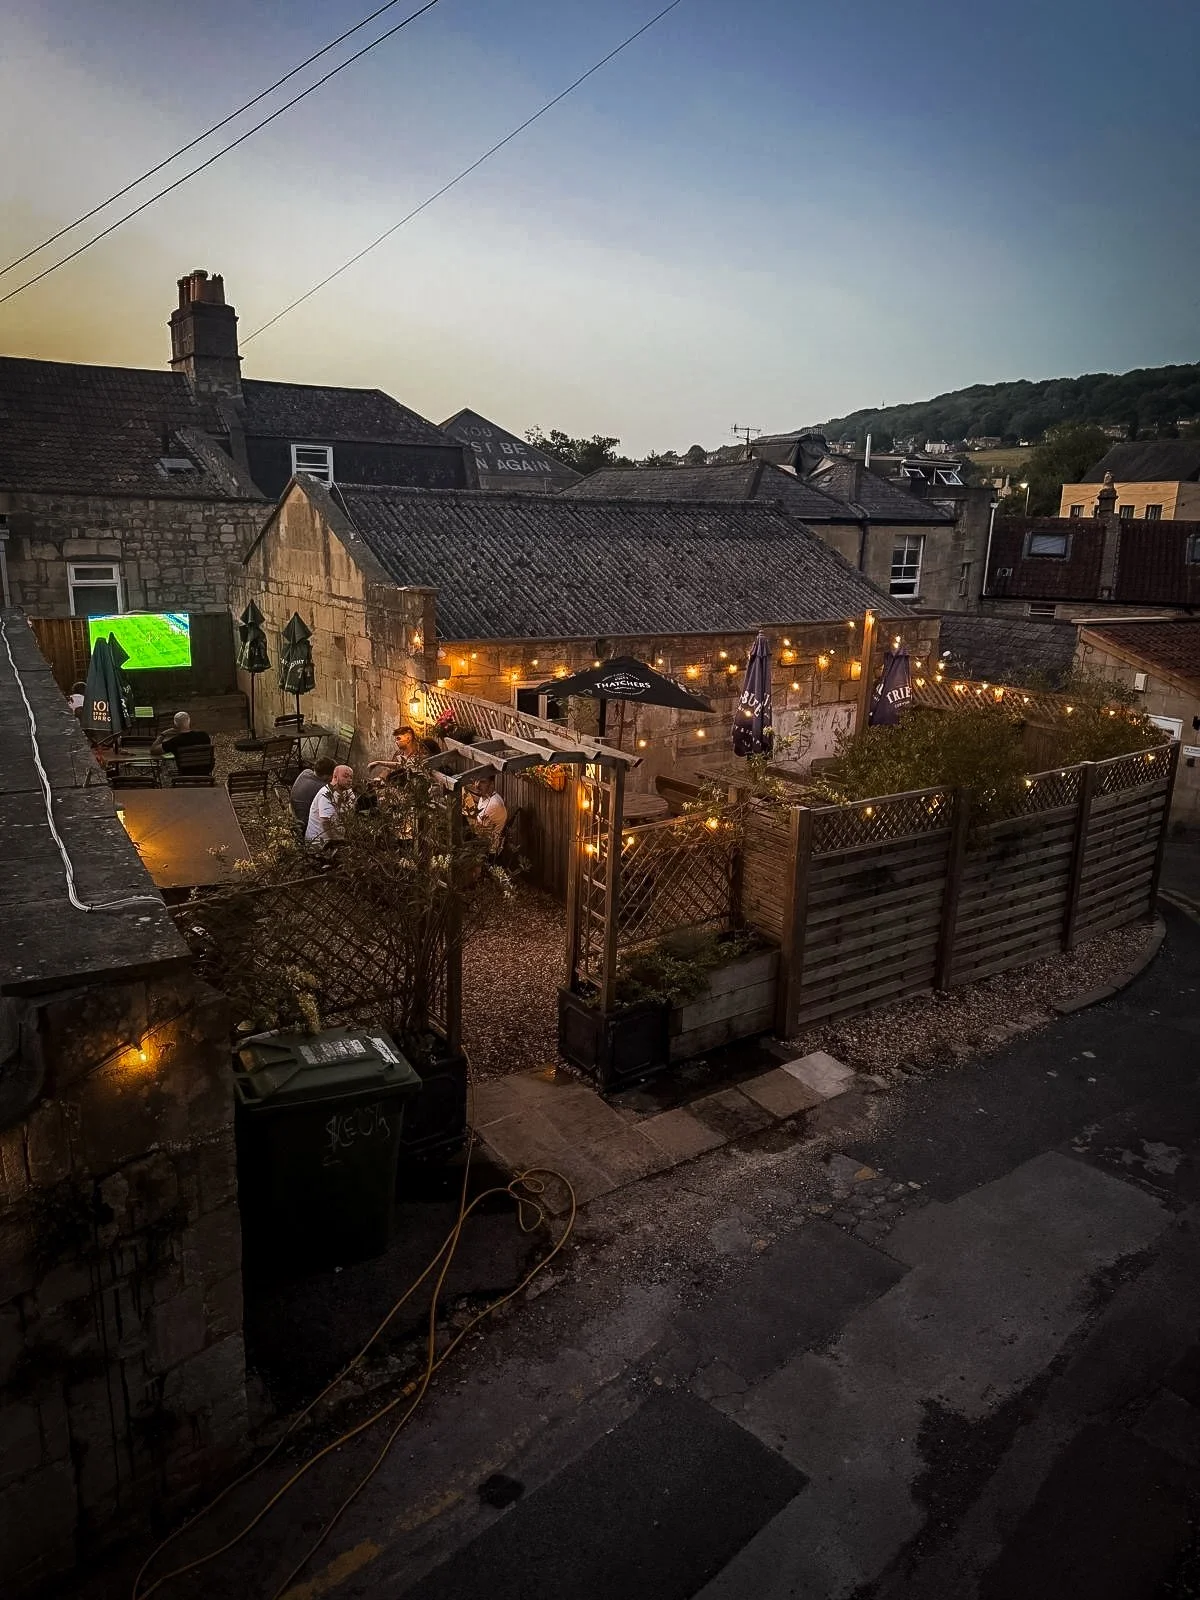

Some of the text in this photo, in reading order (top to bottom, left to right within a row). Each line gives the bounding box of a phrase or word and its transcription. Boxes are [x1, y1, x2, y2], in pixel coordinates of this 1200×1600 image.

[500, 442, 528, 455] BE
[497, 459, 551, 472] AGAIN
[594, 680, 651, 689] THATCHERS
